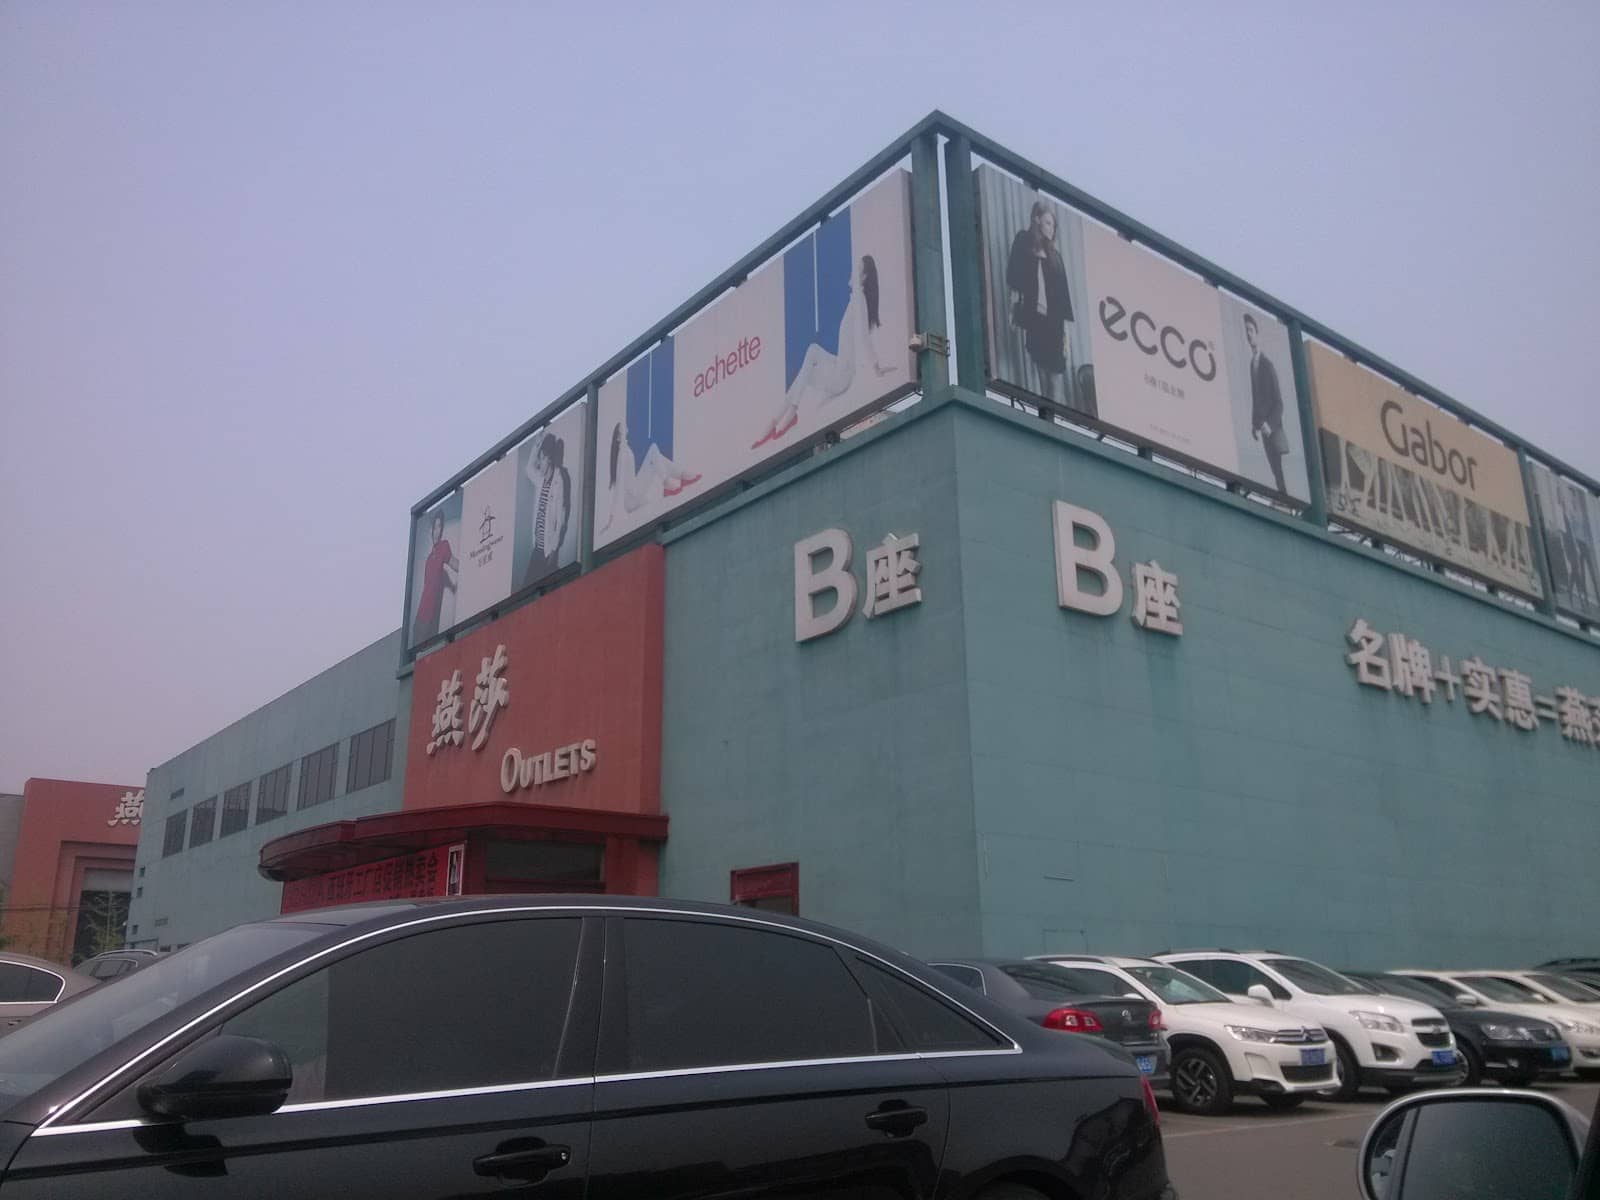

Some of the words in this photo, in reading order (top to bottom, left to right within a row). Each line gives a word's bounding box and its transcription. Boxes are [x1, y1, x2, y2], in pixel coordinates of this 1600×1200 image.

[694, 336, 761, 397] achette
[1099, 296, 1217, 383] ecco
[1380, 399, 1477, 491] Gabor
[794, 528, 922, 642] B座
[1052, 500, 1183, 636] B座
[426, 643, 509, 755] 燕莎
